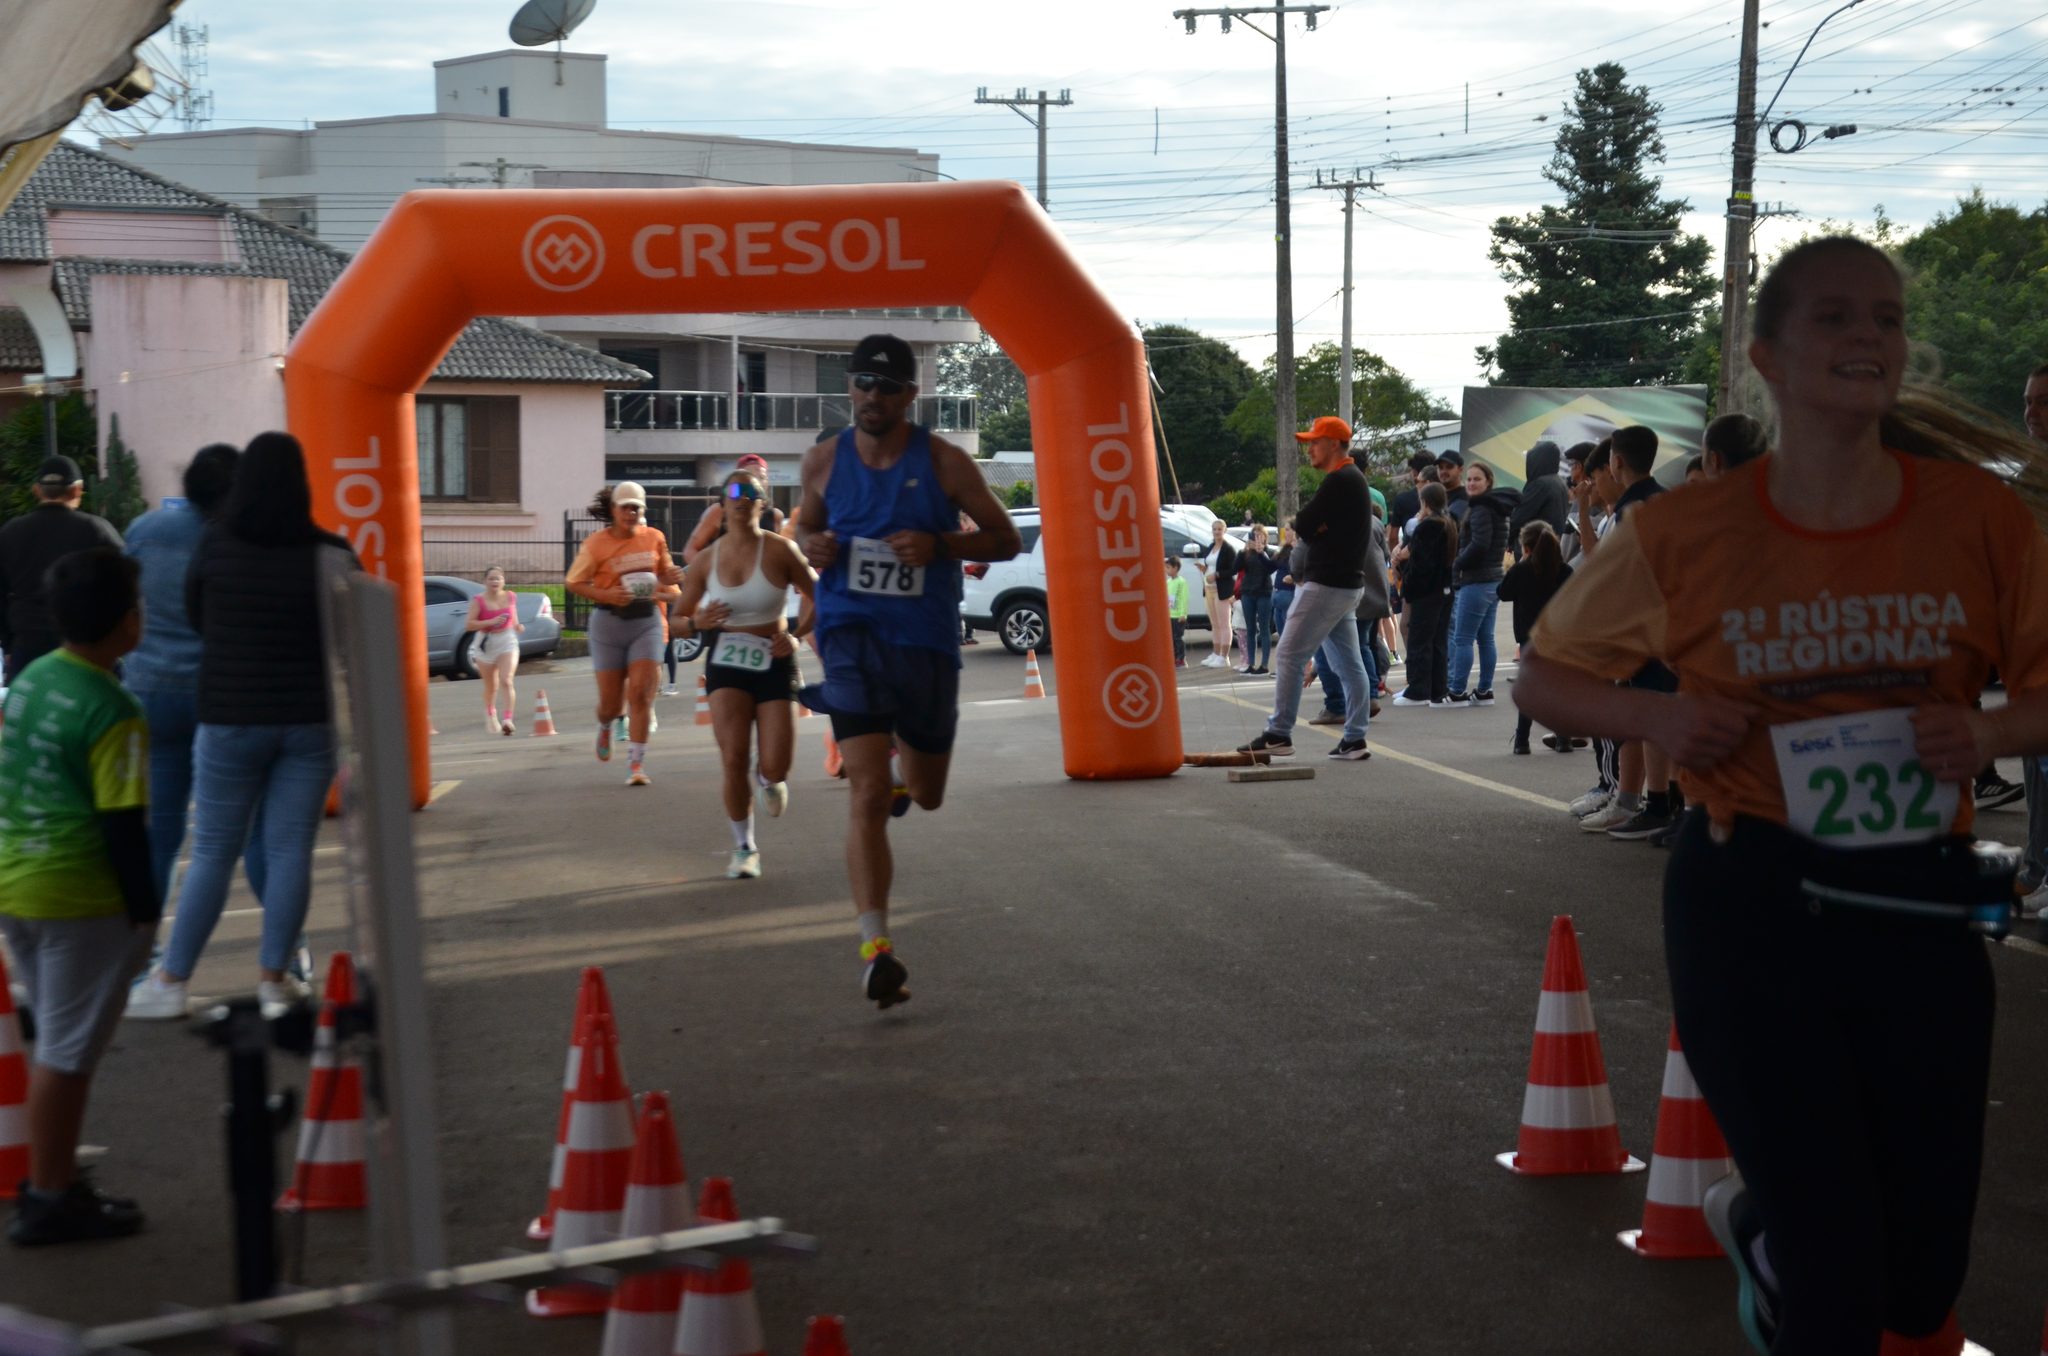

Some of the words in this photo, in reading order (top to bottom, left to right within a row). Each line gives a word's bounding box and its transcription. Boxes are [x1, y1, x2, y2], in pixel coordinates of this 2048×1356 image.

[631, 216, 926, 279] CRESOL
[1087, 401, 1148, 643] CRESOL
[858, 560, 914, 592] 578
[1778, 588, 1968, 639] RÚSTICA
[721, 644, 764, 667] 219
[1735, 626, 1952, 678] REGIONAL
[1808, 759, 1941, 835] 232
